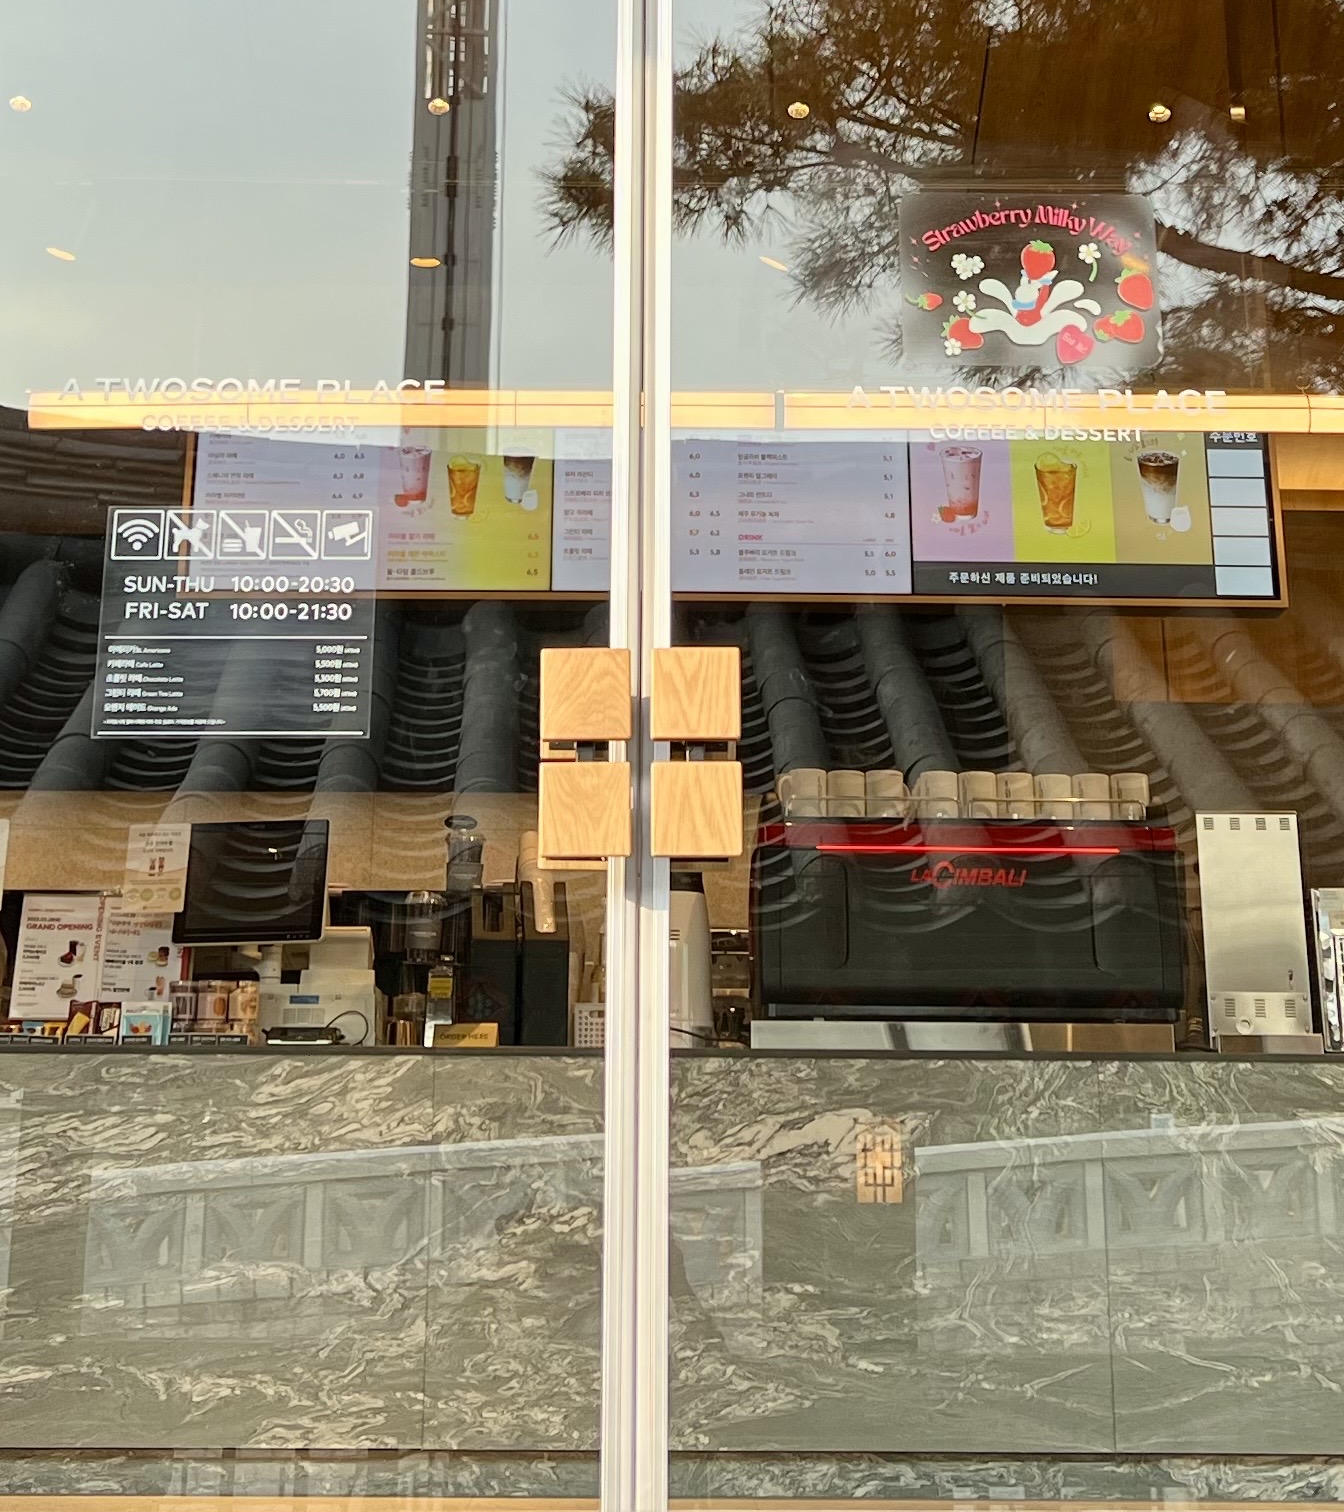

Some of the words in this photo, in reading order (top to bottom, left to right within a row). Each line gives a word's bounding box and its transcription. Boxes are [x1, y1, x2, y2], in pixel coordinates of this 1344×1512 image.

[921, 207, 1032, 252] Strawberry
[1035, 204, 1087, 236] Milky
[1087, 217, 1133, 256] Way
[58, 378, 84, 402] A
[94, 377, 301, 404] TWOSOME
[317, 379, 446, 405] PLACE
[848, 385, 871, 410] A
[880, 385, 1082, 413] TWOSOME
[1097, 388, 1227, 416] PLACE
[141, 414, 231, 432] COFFEE
[236, 416, 252, 433] &
[258, 415, 359, 434] DESSERT
[929, 423, 1018, 441] COFFEE
[1025, 425, 1040, 441] &
[1044, 424, 1144, 444] DESSERT
[123, 575, 215, 594] SUN-THU
[231, 575, 356, 594] 10:00-20:30
[948, 571, 991, 585] 주문하신
[125, 601, 209, 620] FRI-SAT
[229, 602, 353, 621] 10:00-21:30
